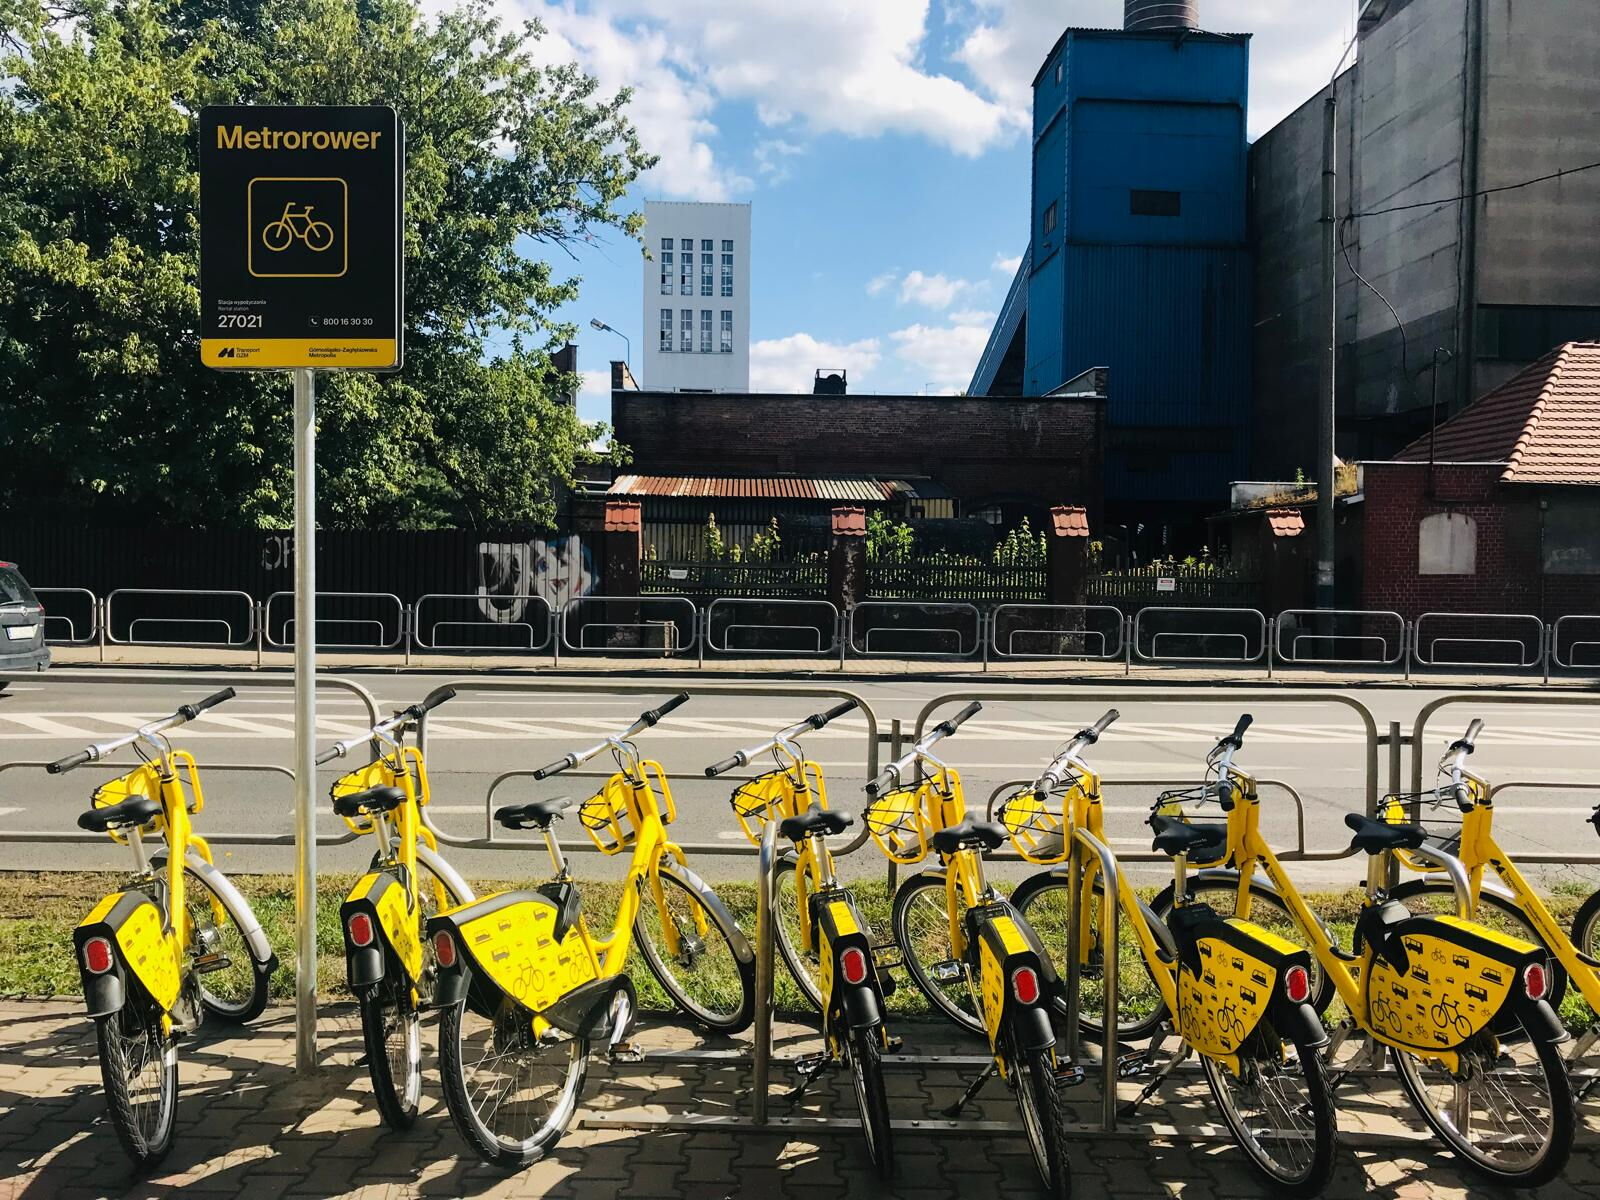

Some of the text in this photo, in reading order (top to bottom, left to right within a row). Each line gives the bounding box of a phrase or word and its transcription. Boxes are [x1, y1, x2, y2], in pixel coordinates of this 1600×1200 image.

[216, 125, 382, 150] Metrorower
[217, 314, 263, 328] 27021
[323, 318, 374, 326] 800 16 30 30
